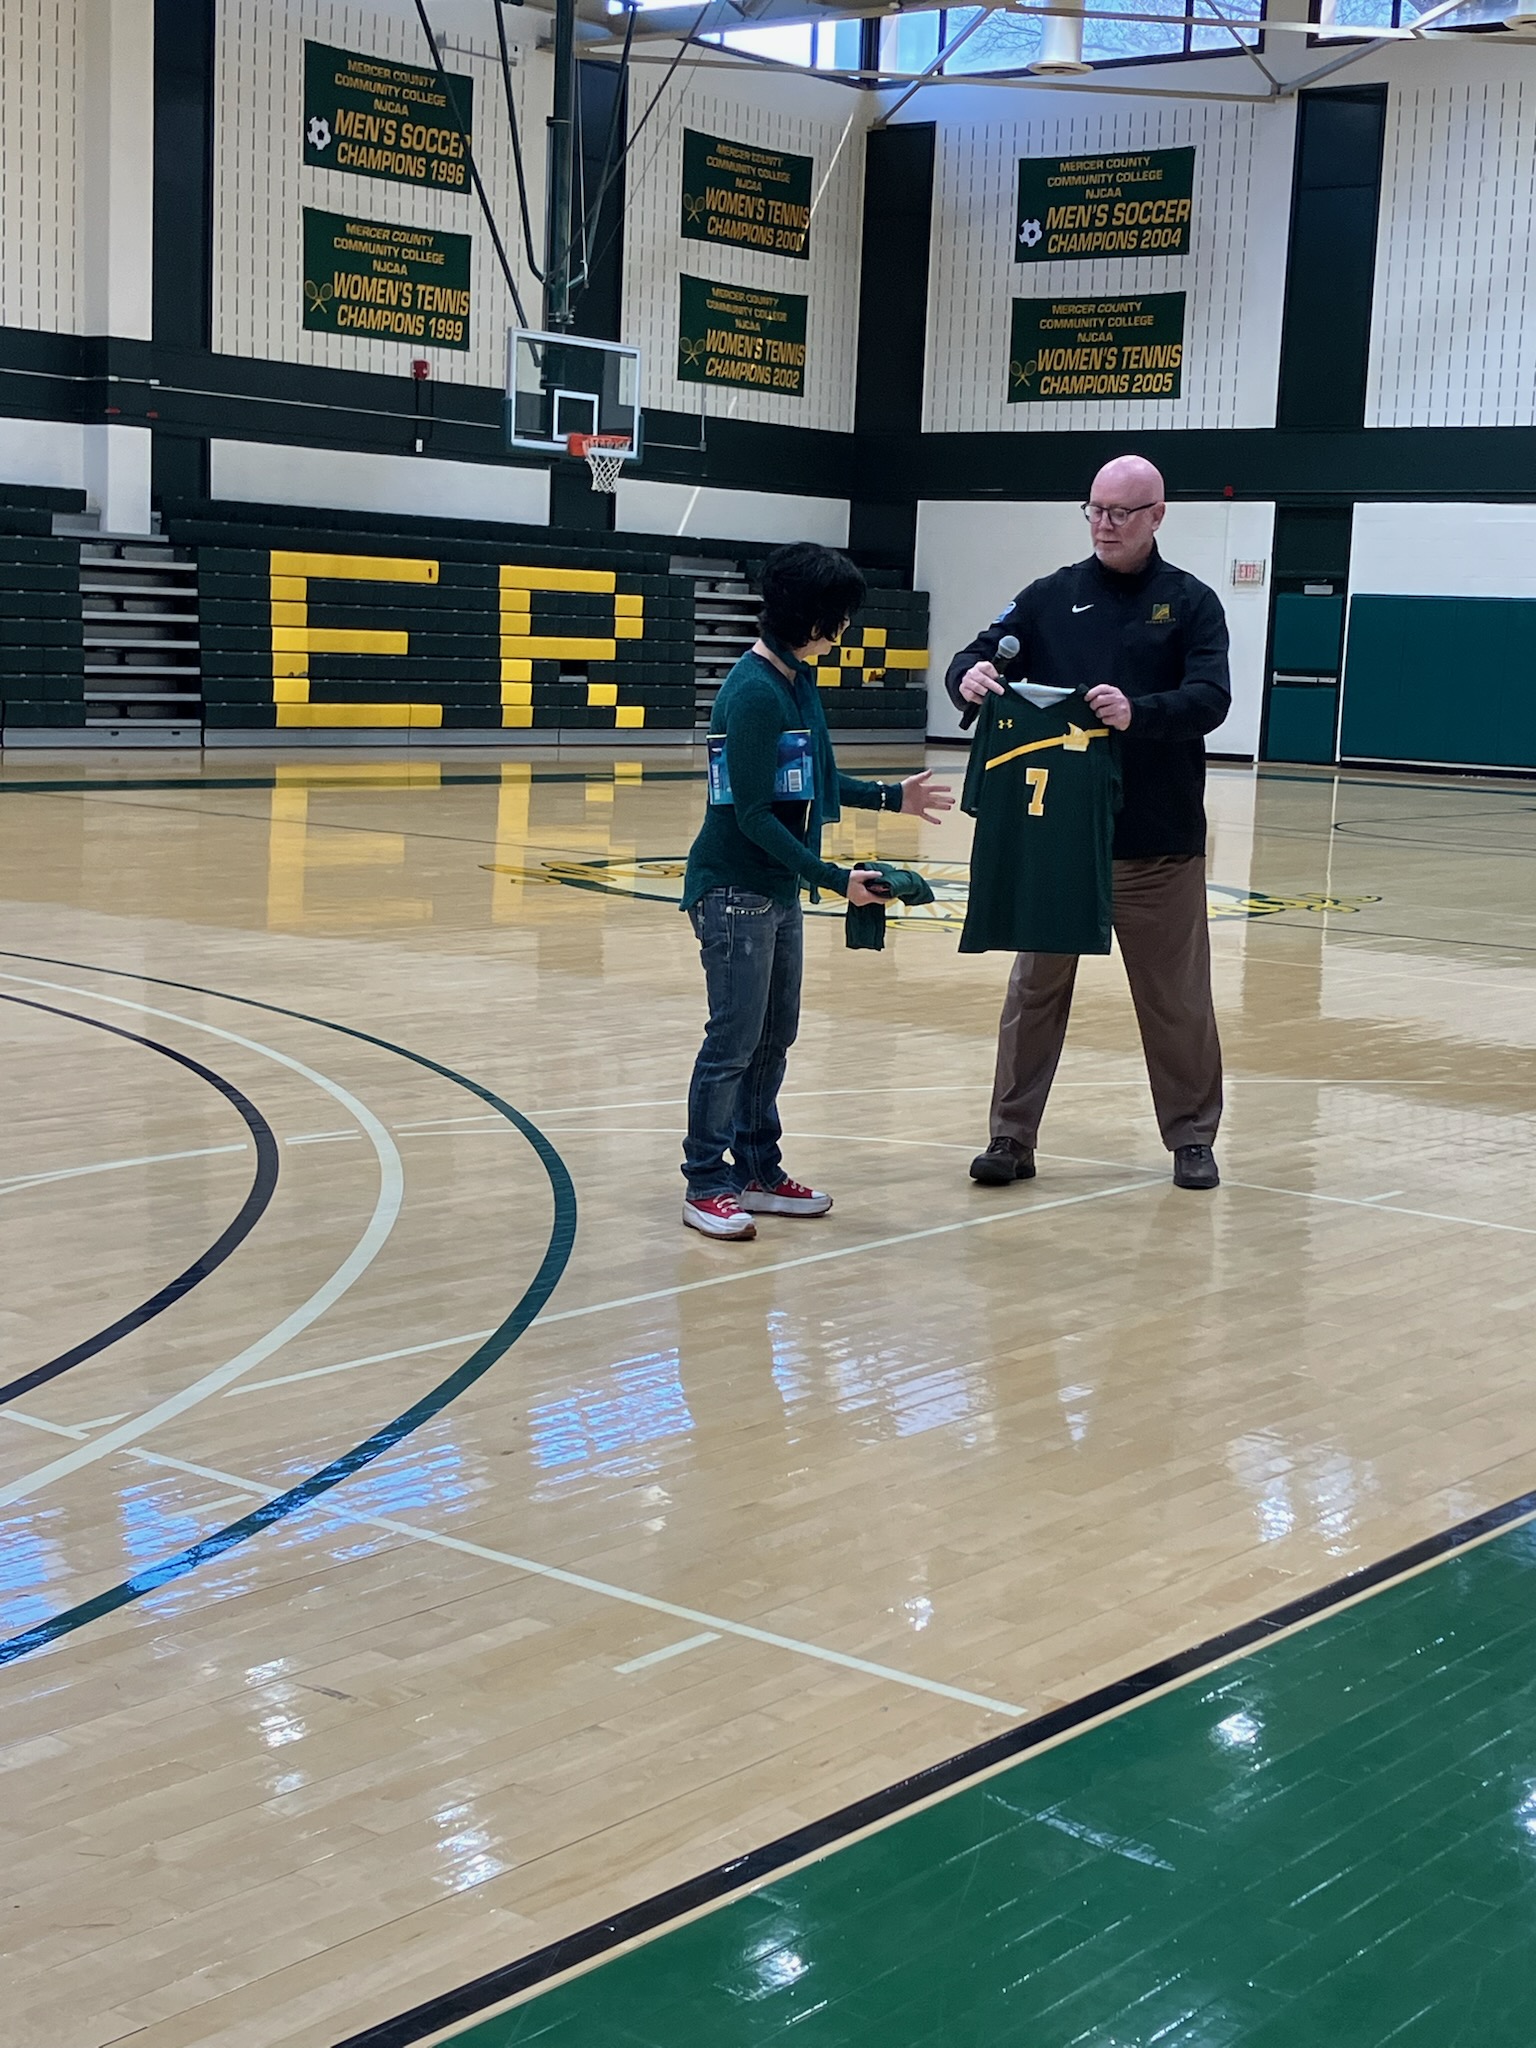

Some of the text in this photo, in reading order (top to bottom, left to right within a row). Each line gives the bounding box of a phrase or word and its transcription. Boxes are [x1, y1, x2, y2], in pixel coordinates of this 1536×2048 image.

[347, 60, 436, 88] MERCER COUNTY
[335, 73, 447, 107] COMMUNITY COLLEGE
[374, 99, 410, 117] NJCAA
[335, 109, 397, 147] MEN'S
[337, 142, 465, 185] CHAMPIONS 1996
[716, 144, 784, 167] MERCER COUNTY
[1060, 156, 1151, 172] MERCER COUNTY
[706, 155, 791, 183] COMMUNITY COLLEGE
[1047, 170, 1163, 187] COMMUNITY COLLEGE
[735, 177, 762, 192] NJCAA
[1085, 187, 1122, 199] NJCAA
[705, 187, 810, 229] WOMEN'S TENNIS
[1046, 199, 1191, 230] MEN'S SOCCER
[345, 223, 434, 247] MERCER COUNTY
[707, 216, 774, 247] CHAMPIONS
[1047, 228, 1182, 254] CHAMPIONS 2004
[334, 237, 445, 265] COMMUNITY COLLEGE
[372, 260, 408, 276] NJCAA
[333, 272, 469, 316] WOMEN'S TENNIS
[711, 287, 779, 307] MERCER COUNTY
[706, 299, 787, 322] COMMUNITY COLLEGE
[1052, 302, 1142, 314] MERCER COUNTY
[337, 304, 463, 341] CHAMPIONS 1999
[735, 318, 760, 332] NJCAA
[1039, 316, 1154, 329] COMMUNITY COLLEGE
[705, 329, 805, 366] WOMEN'S TENNIS
[1077, 332, 1113, 342] NJCAA
[1037, 344, 1182, 372] WOMEN'S TENNIS
[706, 357, 800, 388] CHAMPIONS 2002
[1040, 373, 1174, 395] CHAMPIONS 2005
[1025, 767, 1049, 816] 7
